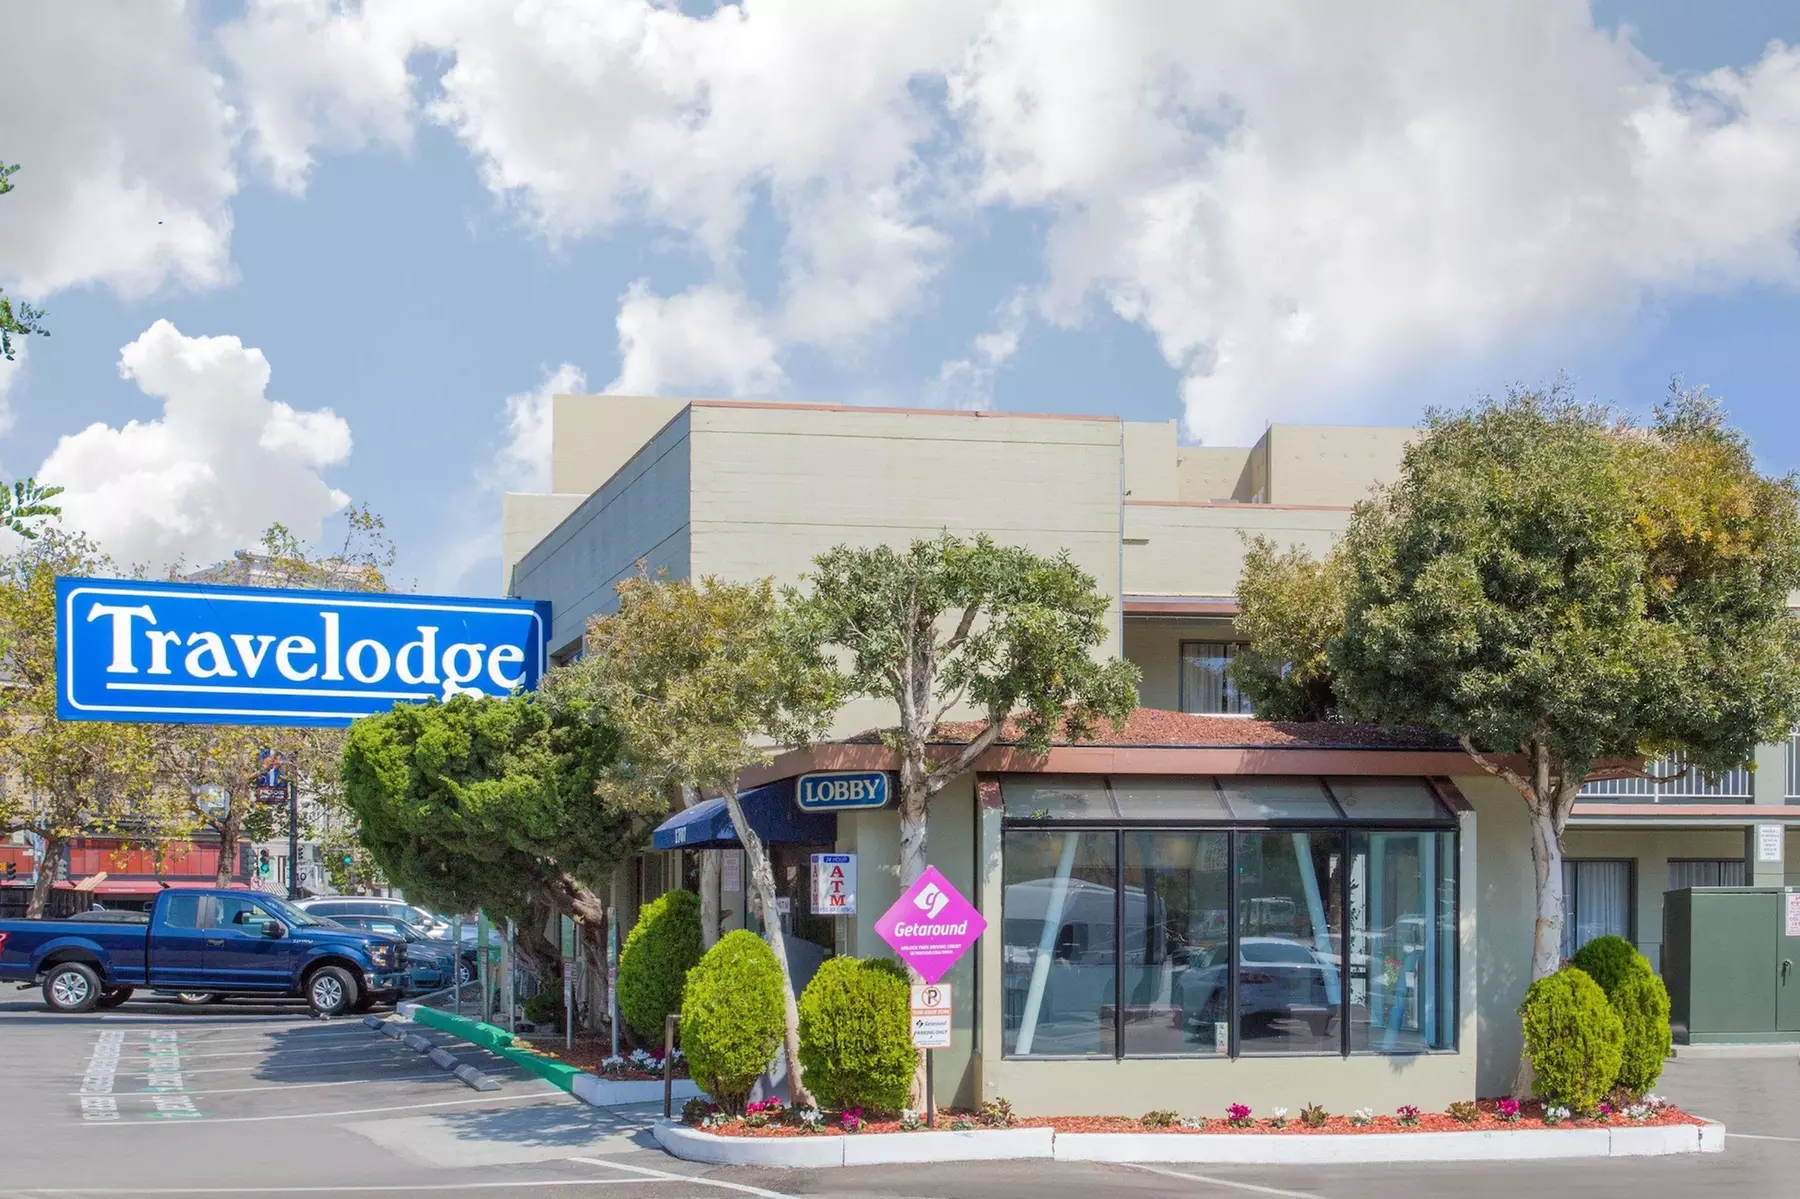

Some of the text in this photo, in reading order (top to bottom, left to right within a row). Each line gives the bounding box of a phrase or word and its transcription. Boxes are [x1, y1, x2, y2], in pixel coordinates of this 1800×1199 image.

[87, 602, 526, 703] Travelodge
[805, 779, 880, 802] LOBBY
[829, 865, 846, 907] ATM
[894, 920, 968, 937] Getaround
